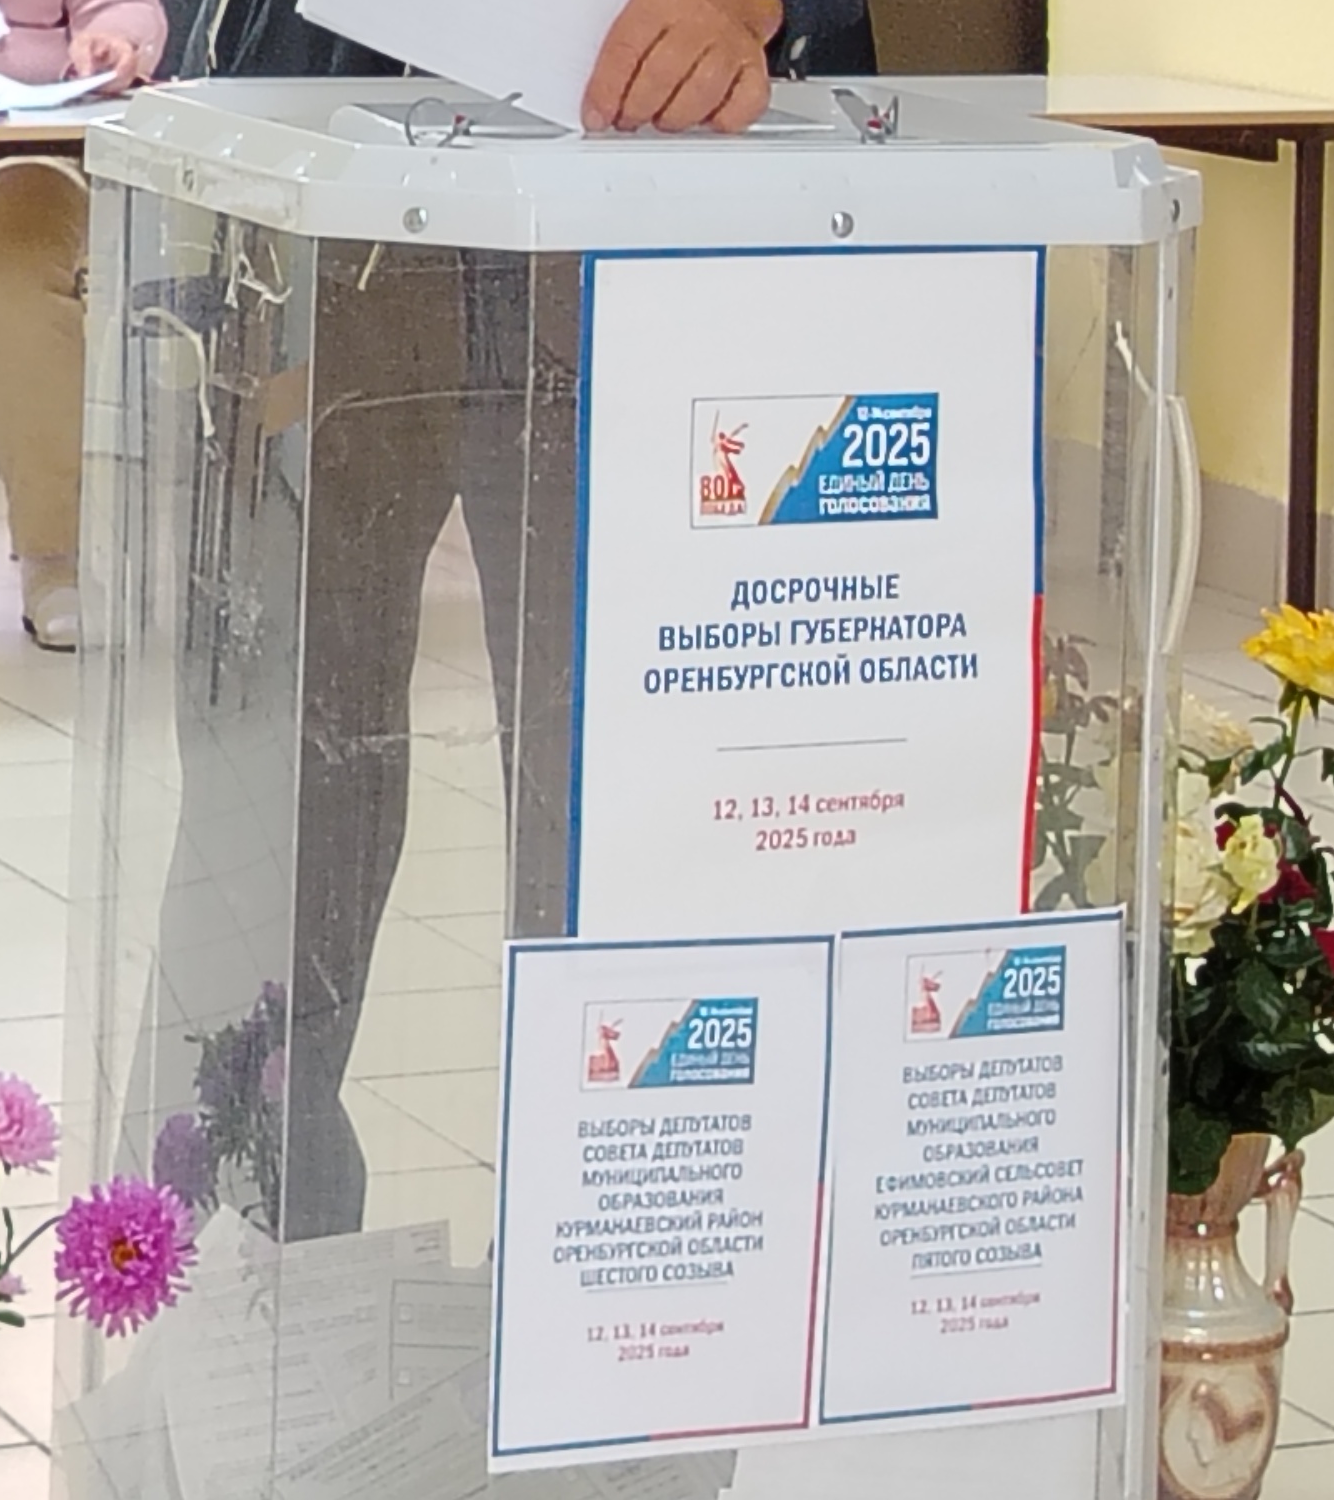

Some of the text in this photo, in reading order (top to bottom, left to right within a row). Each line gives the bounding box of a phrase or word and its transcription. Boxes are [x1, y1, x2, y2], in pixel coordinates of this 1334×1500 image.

[842, 422, 931, 468] 2025
[819, 470, 930, 494] ЕДИНЫЙ ДЕНЬ
[819, 494, 931, 515] ГОЛОСОВАНИЯ
[730, 573, 900, 611] ДОСРОЧНЫЕ
[658, 612, 967, 652] ВЫБОРЫ ГУБЕРНАТОРА
[642, 652, 979, 695] ОРЕНБУРГСКОЙ ОБЛАСТИ
[713, 789, 905, 821] 12, 13, 14 сентября
[755, 826, 857, 852] 2025 года
[1003, 965, 1061, 999] 2025
[687, 1018, 752, 1049] 2025
[902, 1054, 1064, 1085] ВЫБОРЫ ДЕПУТАТОВ
[907, 1082, 1057, 1111] СОВЕТА ДЕПУТАТОВ
[577, 1113, 753, 1139] ВЫБОРЫ ДЕПУТАТОВ
[906, 1108, 1057, 1137] МУНИЦИПАЛЬНОГО
[582, 1137, 744, 1164] СОВЕТА ДЕПУТАТОВ
[922, 1136, 1040, 1163] ОБРАЗОВАНИЯ
[581, 1162, 744, 1187] МУНИЦИПАЛЬНОГО
[875, 1158, 1085, 1195] ЕФИМОВСКИЙ СЕЛЬСОВЕТ
[597, 1187, 725, 1211] ОБРАЗОВАНИЯ
[1022, 1184, 1084, 1206] РАЙОНА
[706, 1208, 764, 1230] РАЙОН
[879, 1212, 1076, 1248] ОРЕНБУРГСКОЙ ОБЛАСТИ
[552, 1234, 765, 1264] ОРЕНБУРГСКОЙ ОБЛАСТИ
[911, 1241, 1043, 1271] ПЯТОГО СОЗЫВА
[579, 1260, 735, 1288] ШЕСТОГО СОЗЫВА
[639, 1322, 657, 1339] 14
